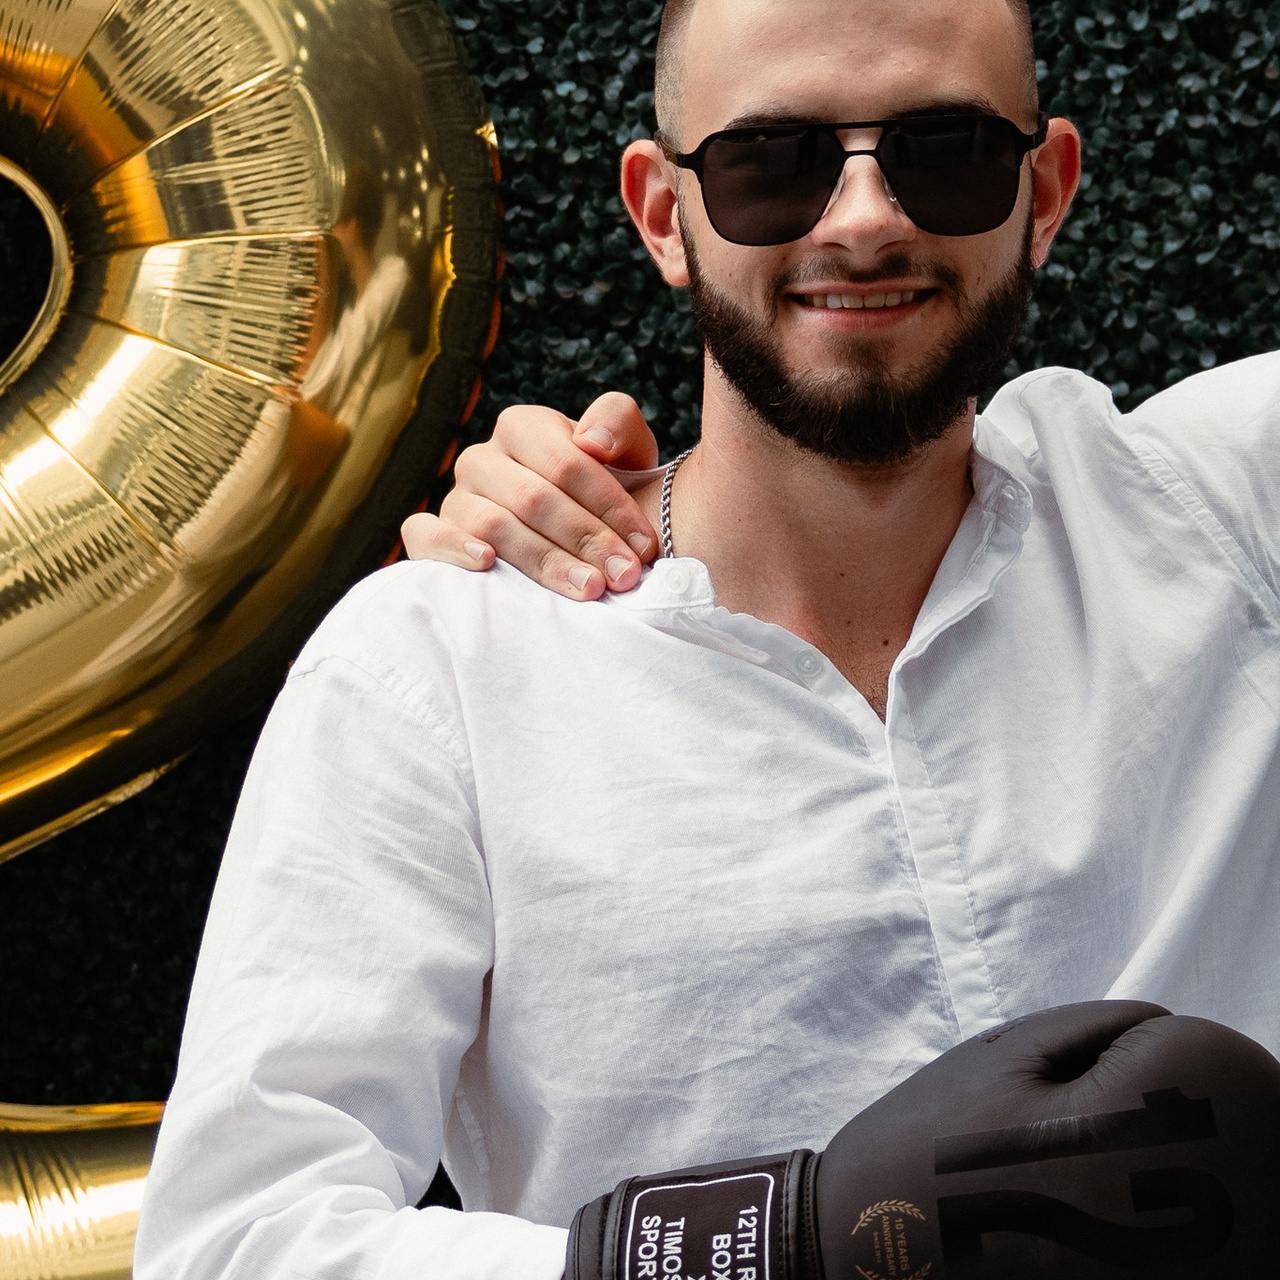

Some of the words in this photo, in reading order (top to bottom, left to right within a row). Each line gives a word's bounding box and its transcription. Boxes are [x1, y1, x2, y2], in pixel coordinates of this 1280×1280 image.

[736, 1205, 759, 1259] 12TH
[882, 1215, 897, 1276] ANNIVERSARY
[895, 1218, 904, 1230] 10
[896, 1232, 910, 1271] YEARS
